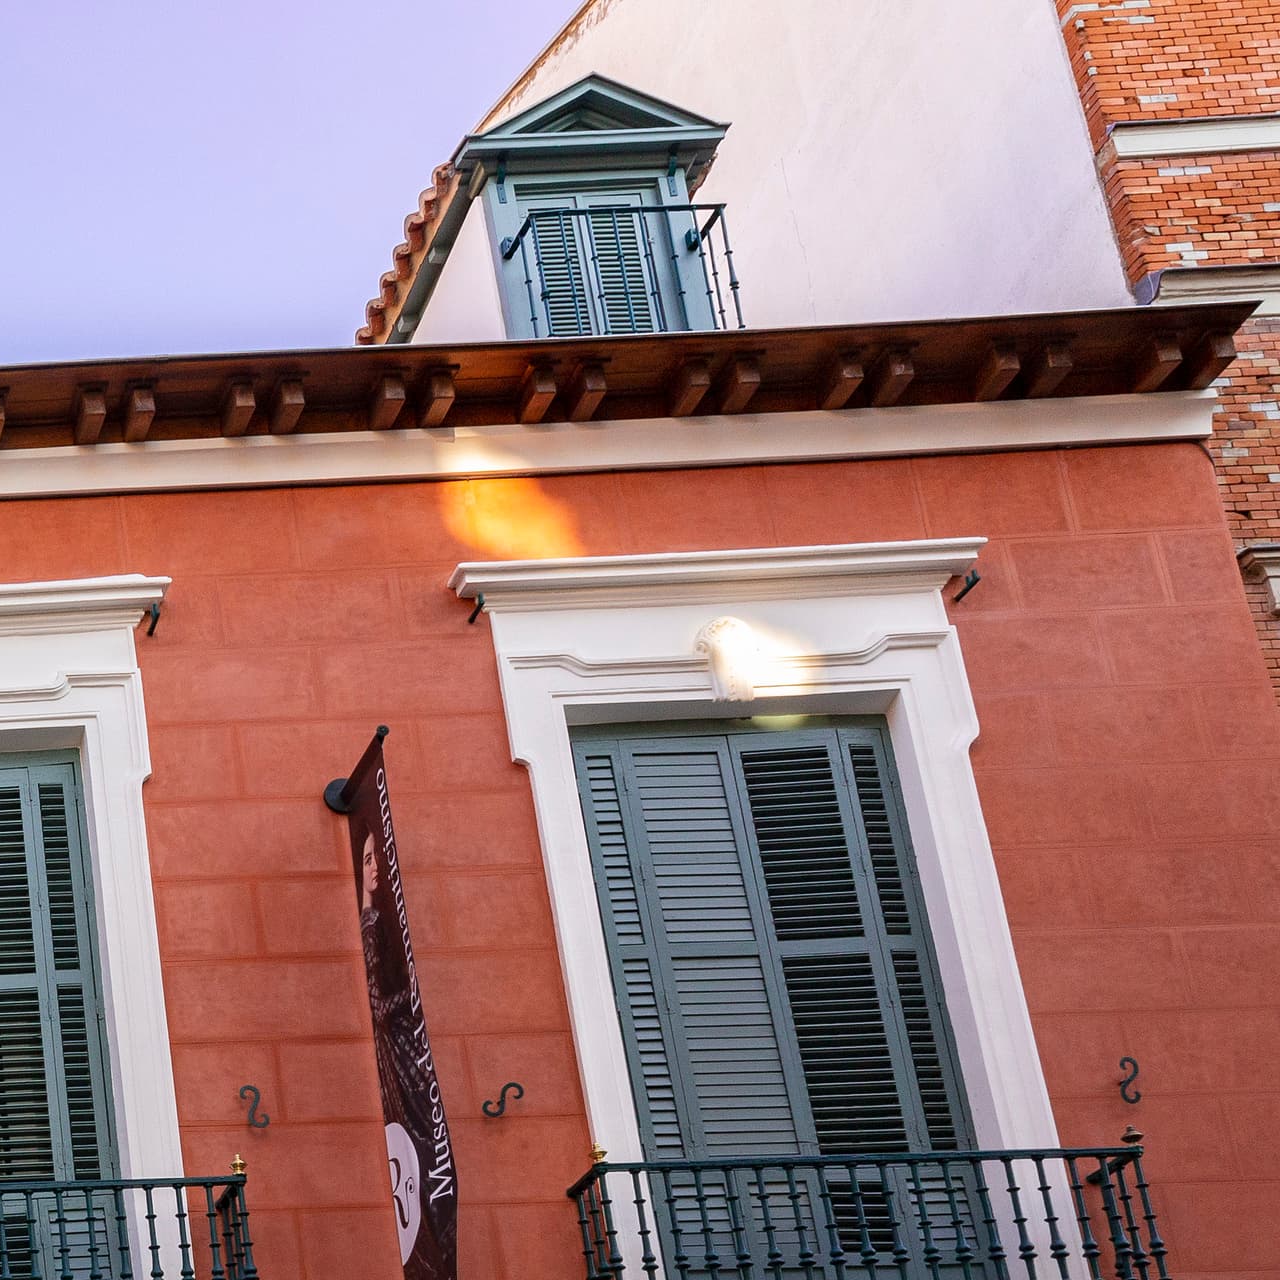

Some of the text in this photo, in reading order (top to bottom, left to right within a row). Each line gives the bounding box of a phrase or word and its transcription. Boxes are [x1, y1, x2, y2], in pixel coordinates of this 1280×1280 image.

[375, 767, 453, 1205] Museo del Romanticismo
